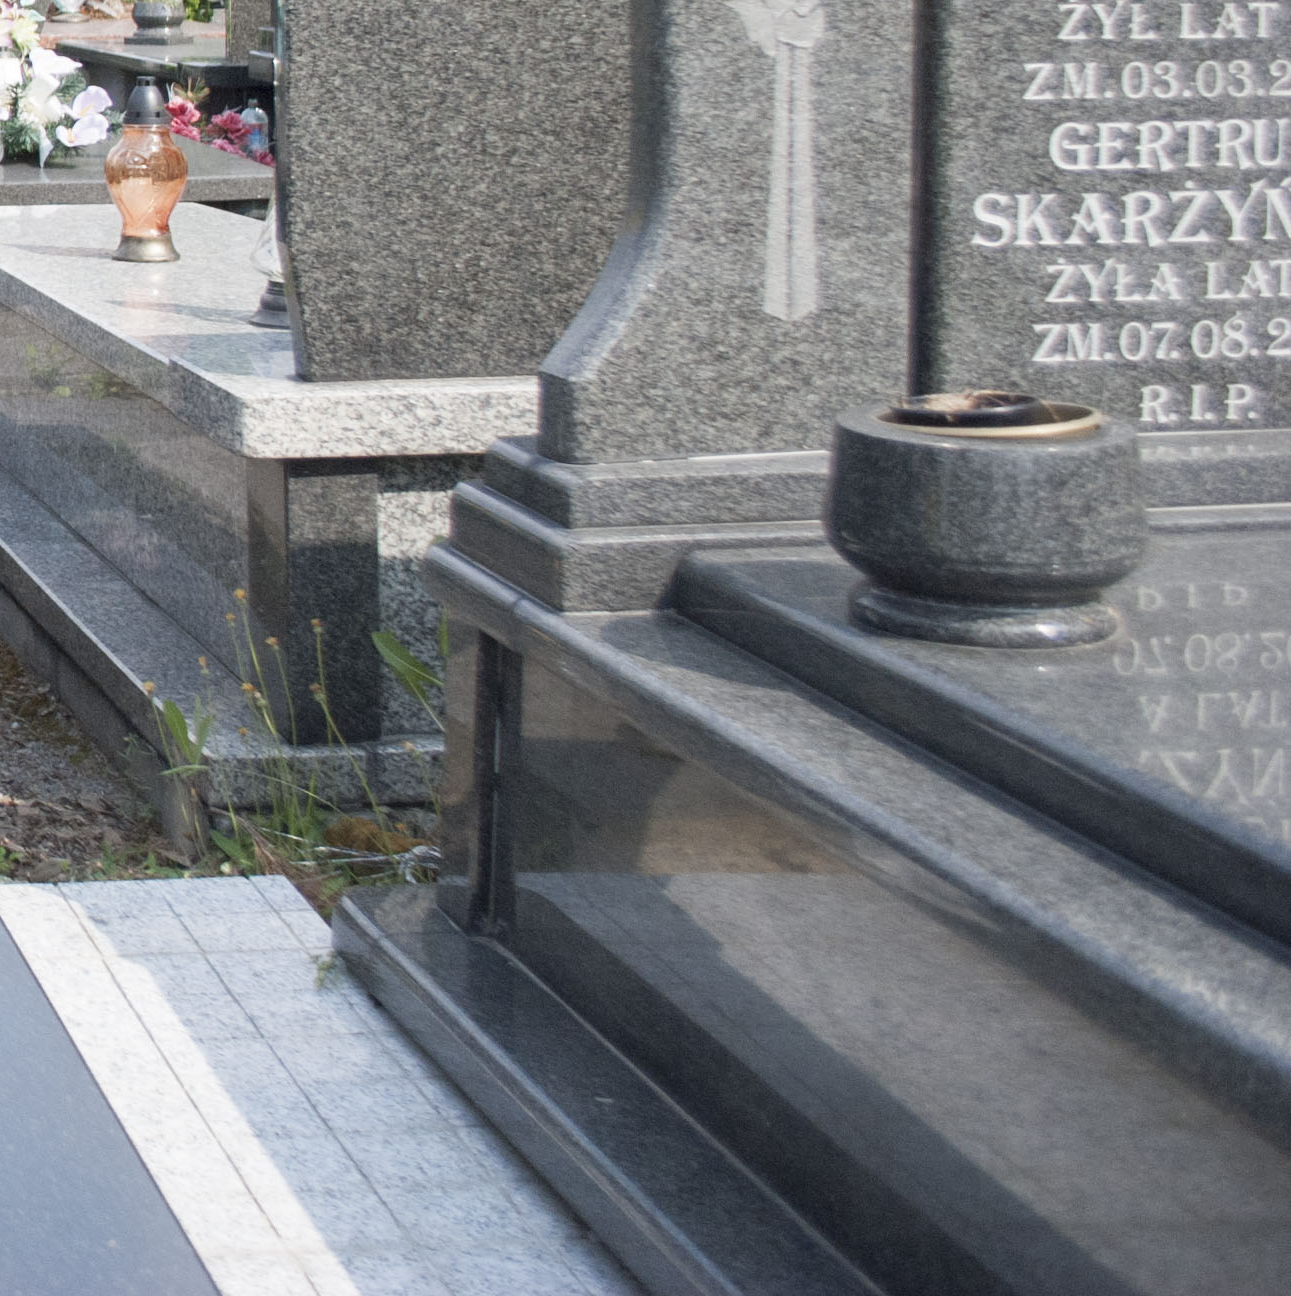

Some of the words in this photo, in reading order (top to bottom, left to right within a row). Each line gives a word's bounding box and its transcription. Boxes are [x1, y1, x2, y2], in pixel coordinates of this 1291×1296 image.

[1179, 2, 1280, 40] LAT
[1049, 118, 1291, 172] GERTRU
[1045, 257, 1184, 303] ŻYŁA
